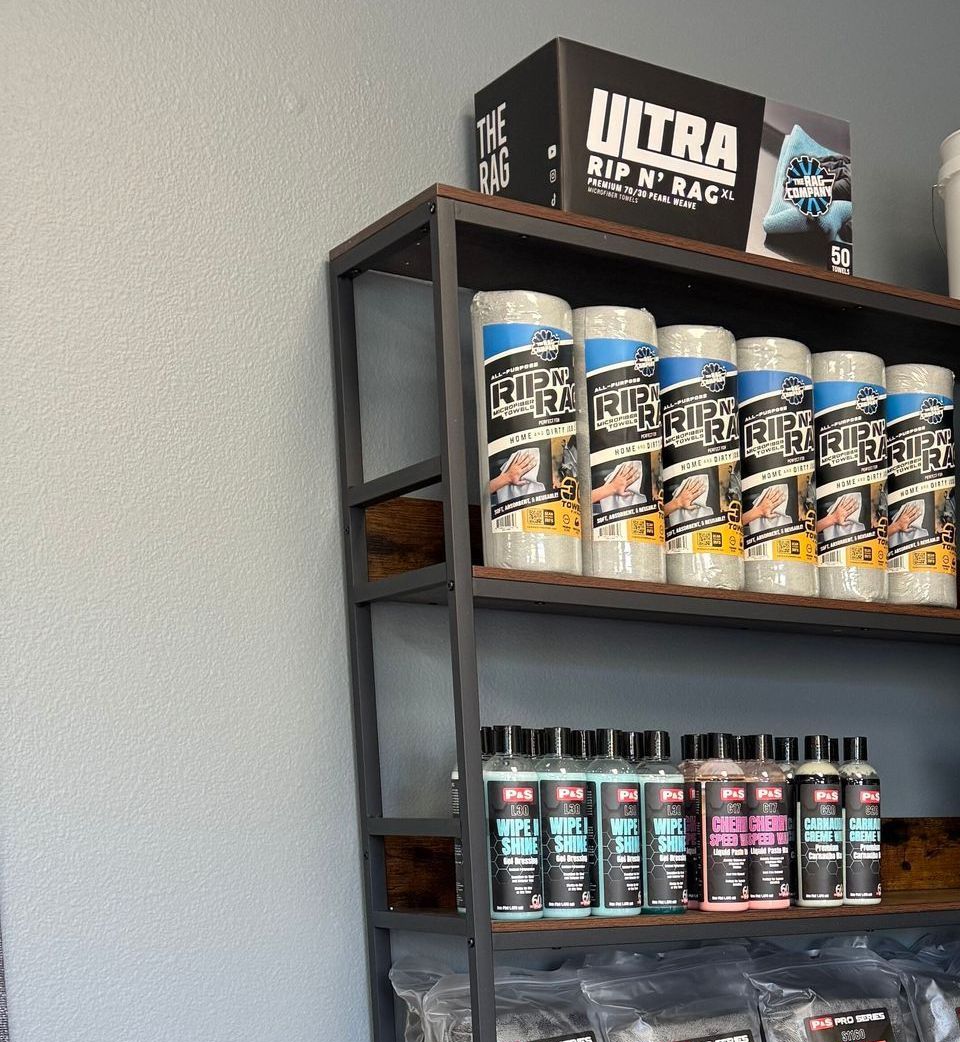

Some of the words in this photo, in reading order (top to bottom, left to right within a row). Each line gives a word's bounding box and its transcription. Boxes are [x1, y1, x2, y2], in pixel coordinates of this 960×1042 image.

[477, 102, 507, 159] THE
[587, 88, 738, 187] ULTRA
[479, 147, 510, 196] RAG
[587, 155, 631, 181] RIP
[637, 168, 664, 191] N'
[672, 177, 719, 204] RAG
[721, 188, 735, 201] XL
[804, 175, 825, 186] RAG
[587, 186, 618, 199] MICROFIBER
[587, 177, 622, 193] PREMIUM
[624, 185, 647, 198] 70/30
[649, 192, 671, 204] PEARL
[674, 198, 696, 210] WEAVE
[787, 186, 832, 199] COMPANY
[831, 246, 850, 268] 50
[491, 362, 538, 380] ALL-PURPOSE
[491, 370, 549, 408] RIP
[594, 378, 640, 393] ALL-PURPOSE
[493, 399, 534, 416] MICROFIBER
[504, 405, 534, 419] TOWELS
[594, 386, 638, 425] RIP
[663, 401, 717, 439] RIP
[510, 433, 532, 444] HOME
[546, 426, 565, 436] DIRTY
[745, 415, 798, 450] RIP
[614, 446, 635, 456] HOME
[821, 425, 870, 460] RIP
[890, 434, 937, 467] RIP
[762, 469, 782, 480] HOME
[836, 478, 856, 489] HOME
[505, 788, 533, 800] P&S
[558, 788, 584, 800] P&S
[619, 790, 638, 800] P&S
[661, 789, 684, 800] P&S
[722, 788, 744, 800] P&S
[757, 788, 782, 800] P&S
[816, 790, 838, 800] P&S
[862, 791, 880, 800] P&S
[496, 818, 532, 837] WIPE
[549, 817, 580, 835] WIPE
[611, 818, 638, 836] WIPE
[653, 818, 683, 836] WIPE
[501, 836, 539, 855] SHINE
[554, 836, 588, 853] SHINE
[710, 833, 738, 847] SPEED
[812, 1018, 833, 1029] P&S
[835, 1016, 854, 1026] PRO
[856, 1013, 885, 1022] SERIES
